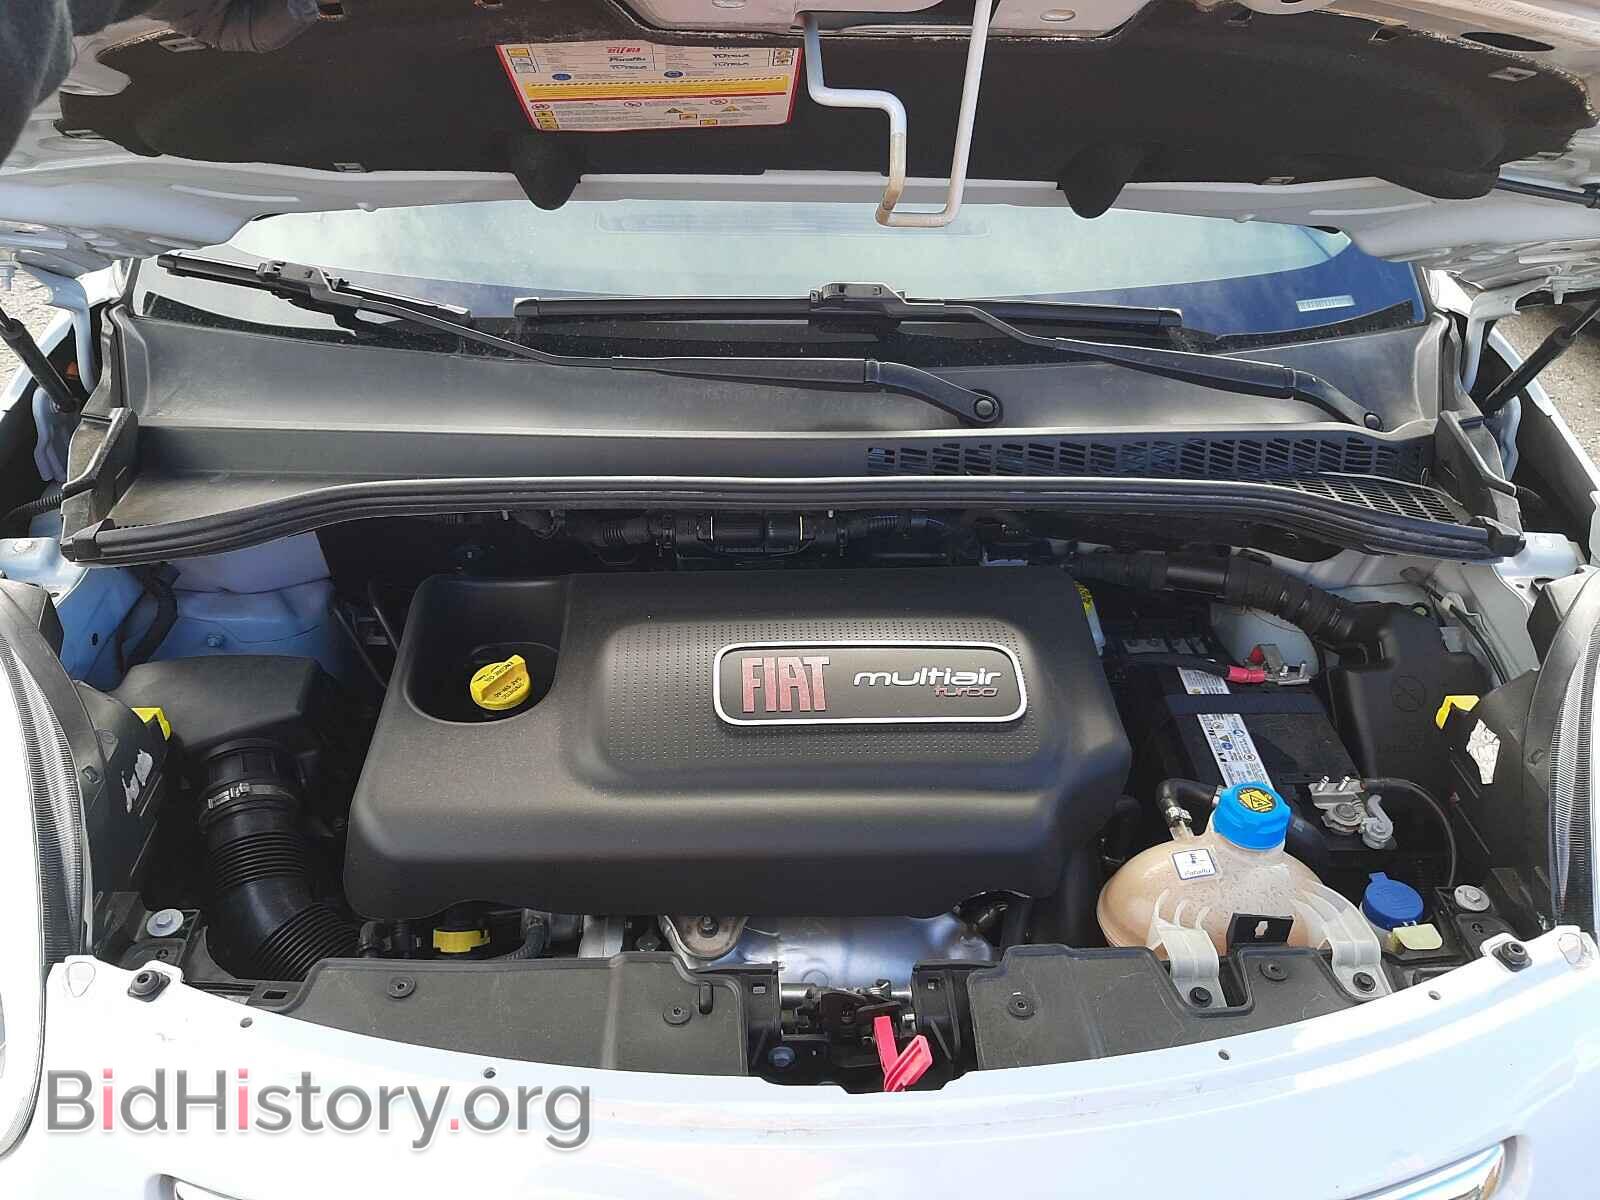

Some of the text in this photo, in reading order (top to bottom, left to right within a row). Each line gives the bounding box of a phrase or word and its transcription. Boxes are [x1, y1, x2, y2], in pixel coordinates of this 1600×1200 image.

[741, 655, 830, 714] FIAT
[853, 667, 1002, 686] multiair
[934, 685, 1000, 698] turbo
